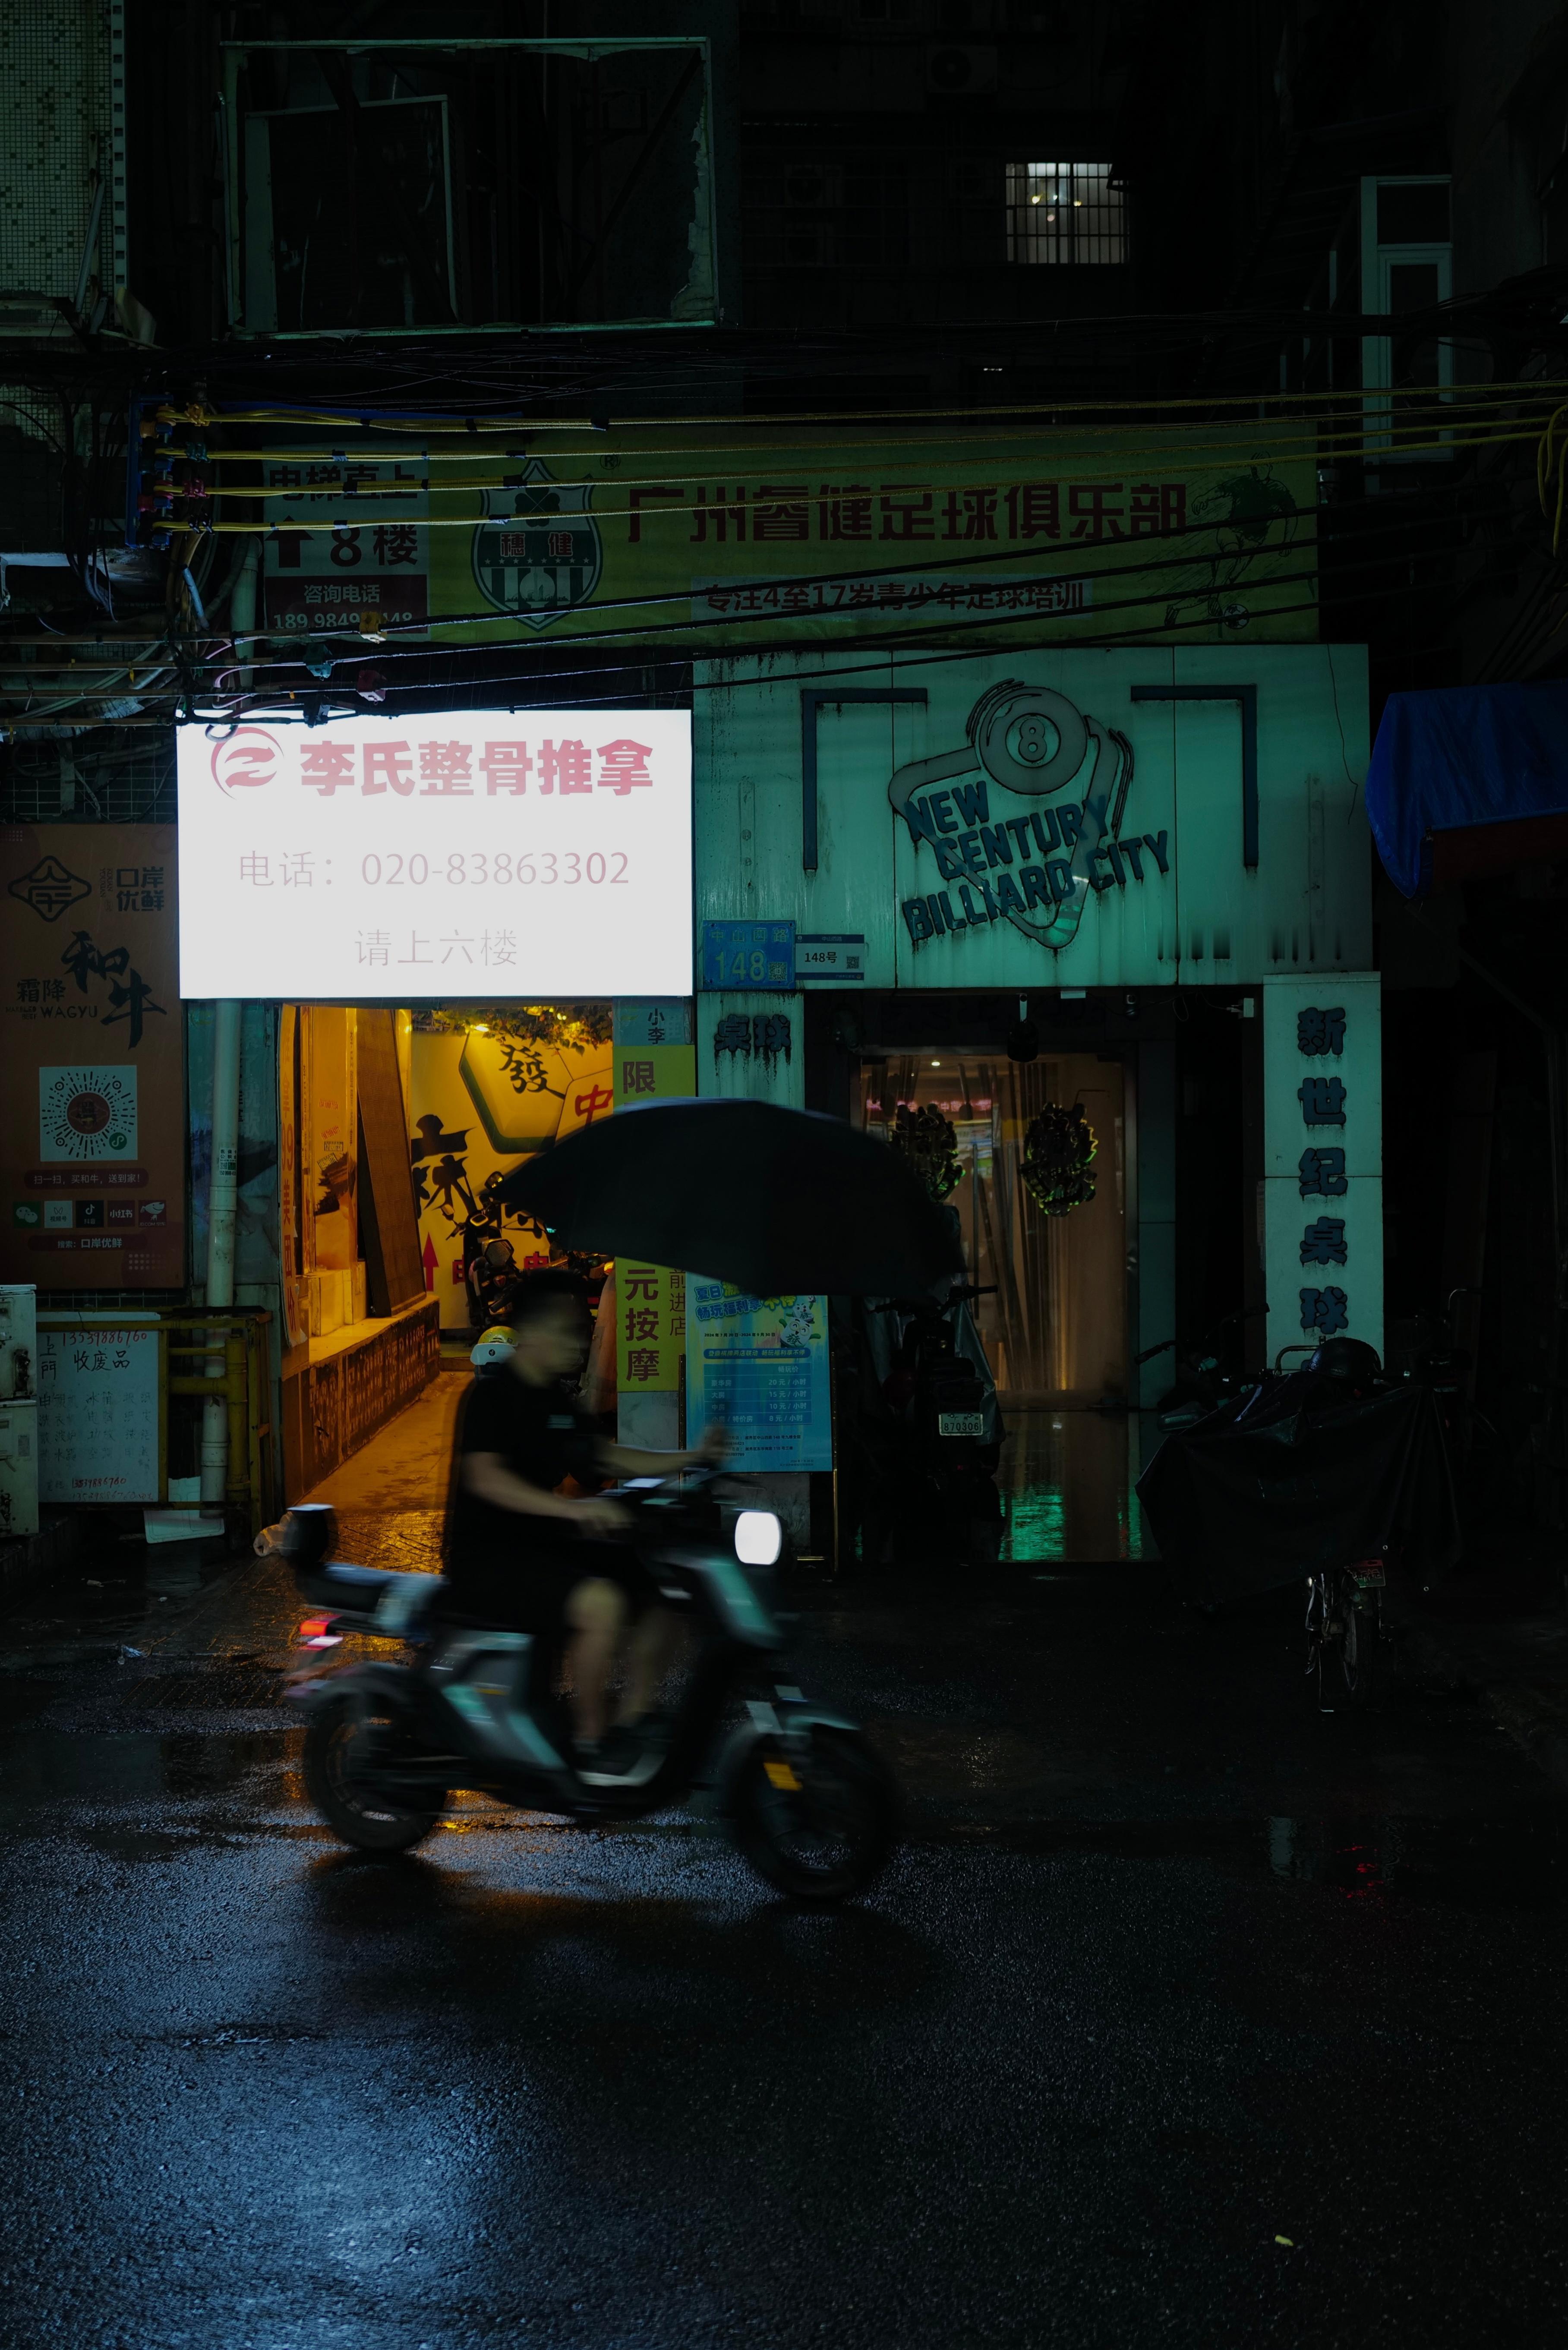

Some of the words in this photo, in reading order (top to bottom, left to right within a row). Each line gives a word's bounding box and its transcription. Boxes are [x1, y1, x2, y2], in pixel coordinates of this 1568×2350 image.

[270, 464, 418, 502] 电梯直上
[628, 483, 1186, 543] 广州睿健足球俱乐部
[303, 584, 381, 604] 咨询电话
[706, 582, 1083, 612] 专注4至17岁青少年足球培训
[300, 738, 654, 796] 李氏整骨推拿
[903, 780, 990, 841] NEW
[934, 795, 1108, 880] CENTURY
[116, 867, 164, 888] 口岸
[360, 852, 630, 886] 020-83863302
[902, 859, 1076, 941] BILLIARD
[1085, 830, 1170, 890] CITY
[116, 890, 165, 912] 优鲜
[355, 929, 518, 967] 请上六楼
[710, 927, 789, 943] 中山四路
[715, 951, 765, 982] 148
[805, 952, 837, 963] 148号
[17, 978, 66, 1003] 霜降
[61, 931, 167, 1050] 和牛
[41, 1006, 98, 1019] WAGYU
[647, 1008, 665, 1045] 小李
[714, 1014, 791, 1052] 桌球
[623, 1060, 656, 1094] 限
[1297, 1007, 1348, 1372] 新世纪桌球
[110, 1209, 133, 1219] 小红书
[81, 1237, 123, 1248] 口岸优鲜
[625, 1269, 659, 1382] 元按摩
[943, 1422, 980, 1431] 870306
